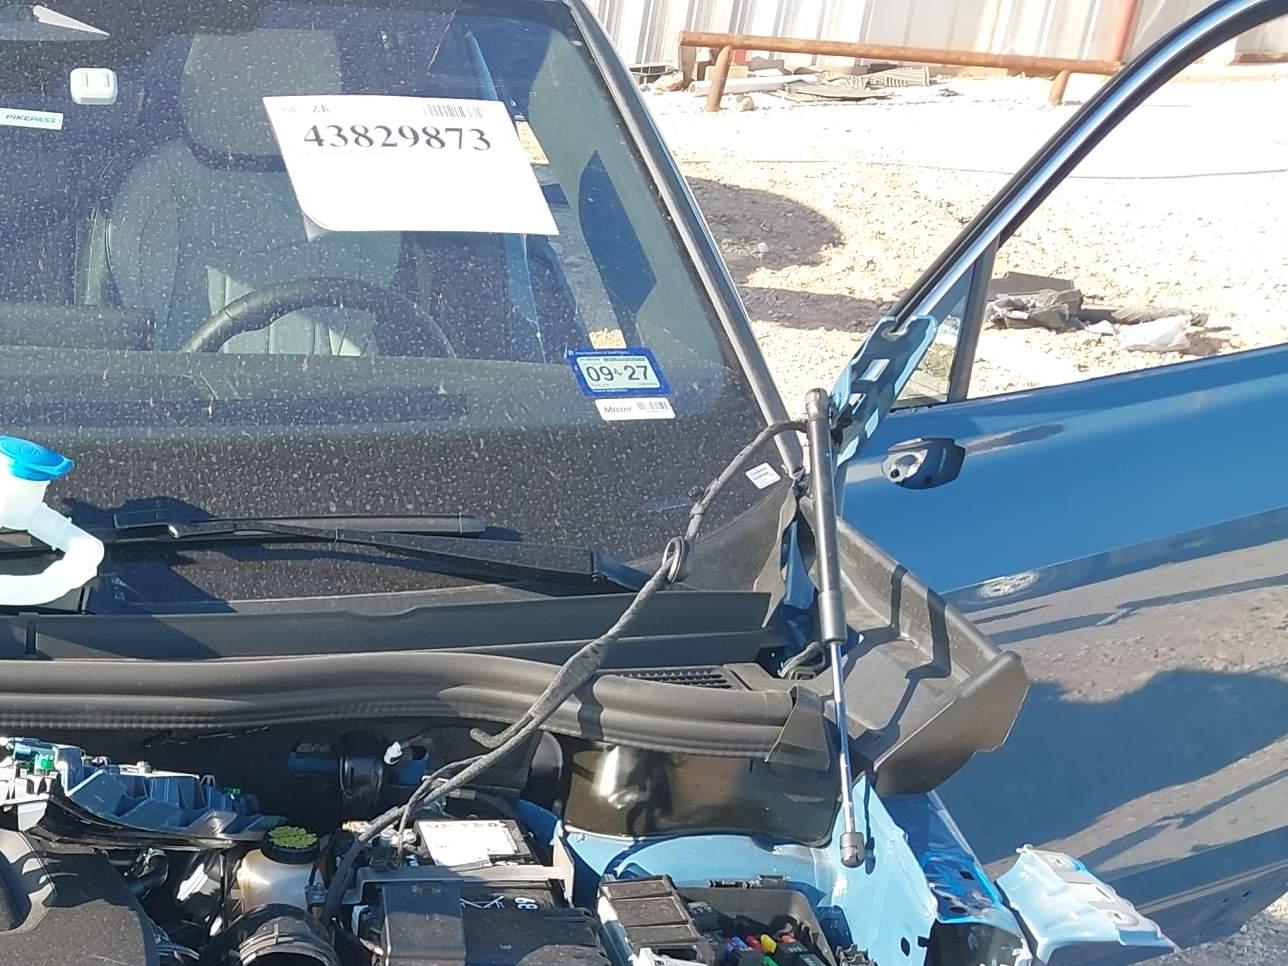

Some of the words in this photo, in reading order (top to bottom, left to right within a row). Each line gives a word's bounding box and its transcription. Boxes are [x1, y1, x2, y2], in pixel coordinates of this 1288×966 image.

[303, 124, 492, 151] 43829873
[585, 365, 615, 382] 09
[623, 364, 649, 381] 27
